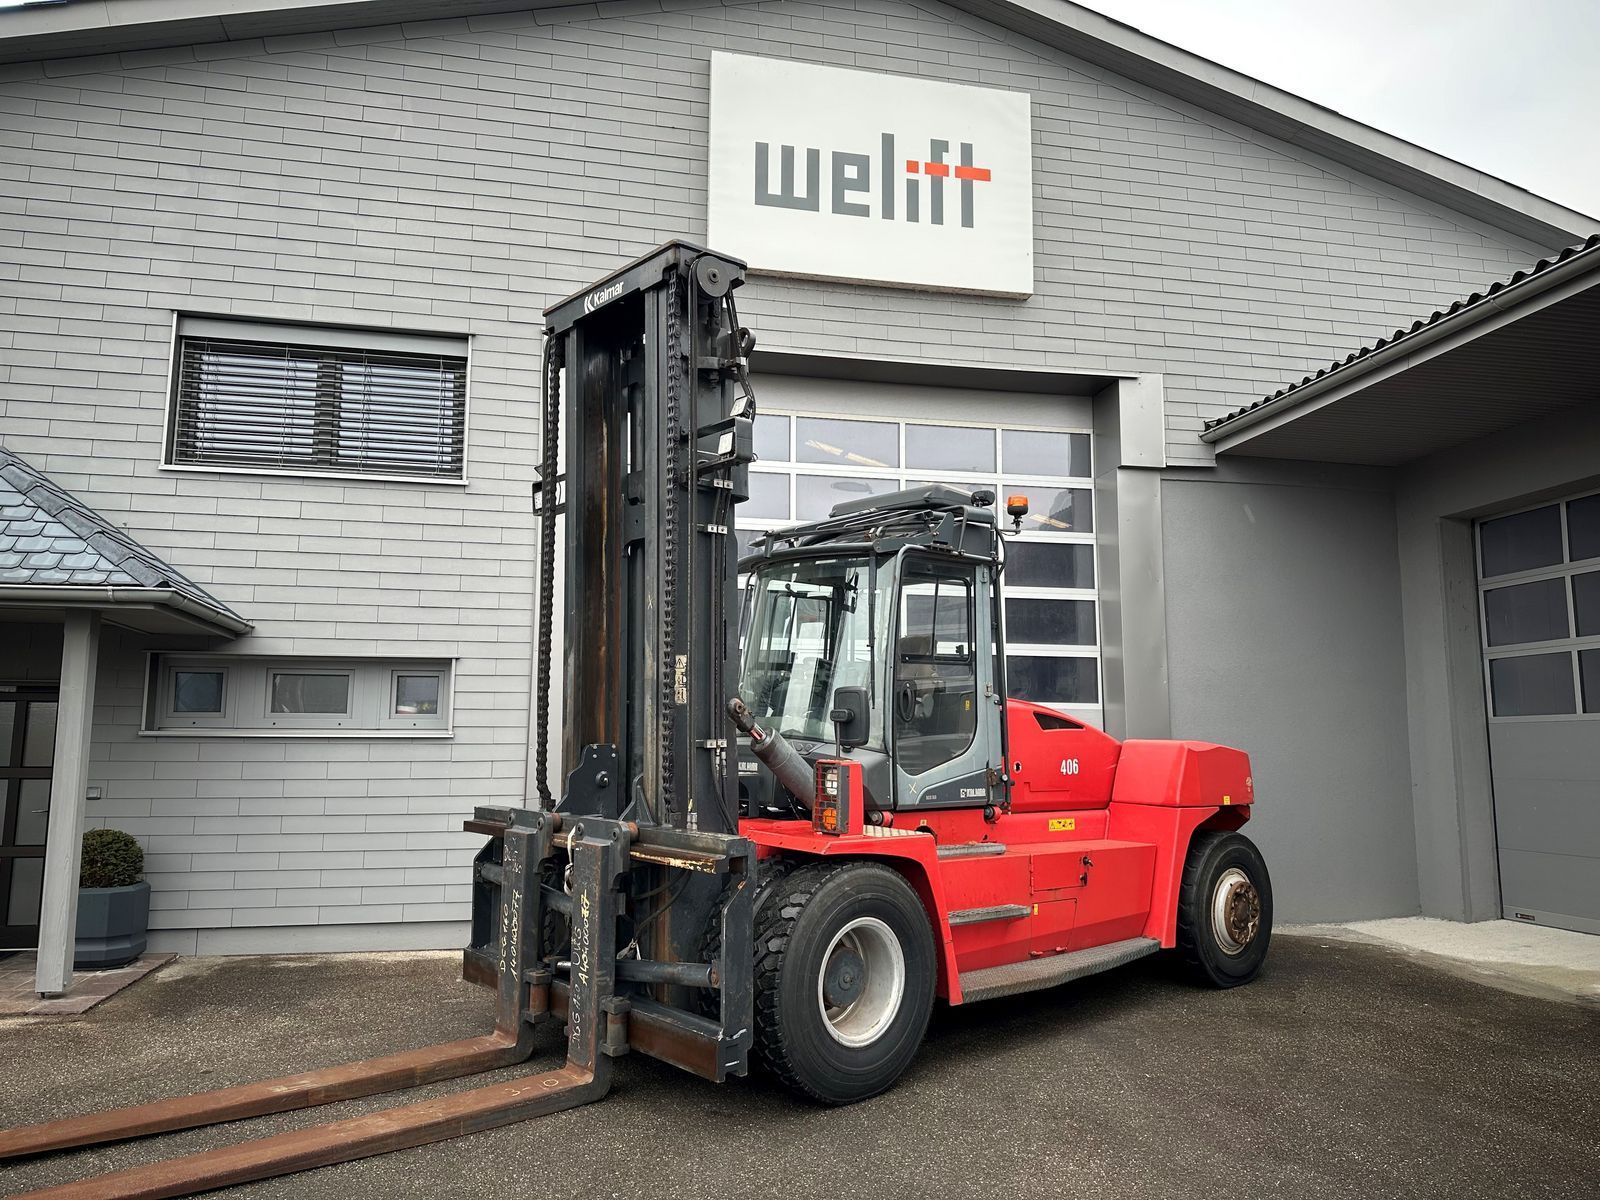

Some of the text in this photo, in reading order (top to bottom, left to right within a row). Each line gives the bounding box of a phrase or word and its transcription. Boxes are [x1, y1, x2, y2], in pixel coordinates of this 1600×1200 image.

[755, 132, 991, 229] welift
[593, 281, 624, 307] Kalmar
[1060, 758, 1079, 776] 406
